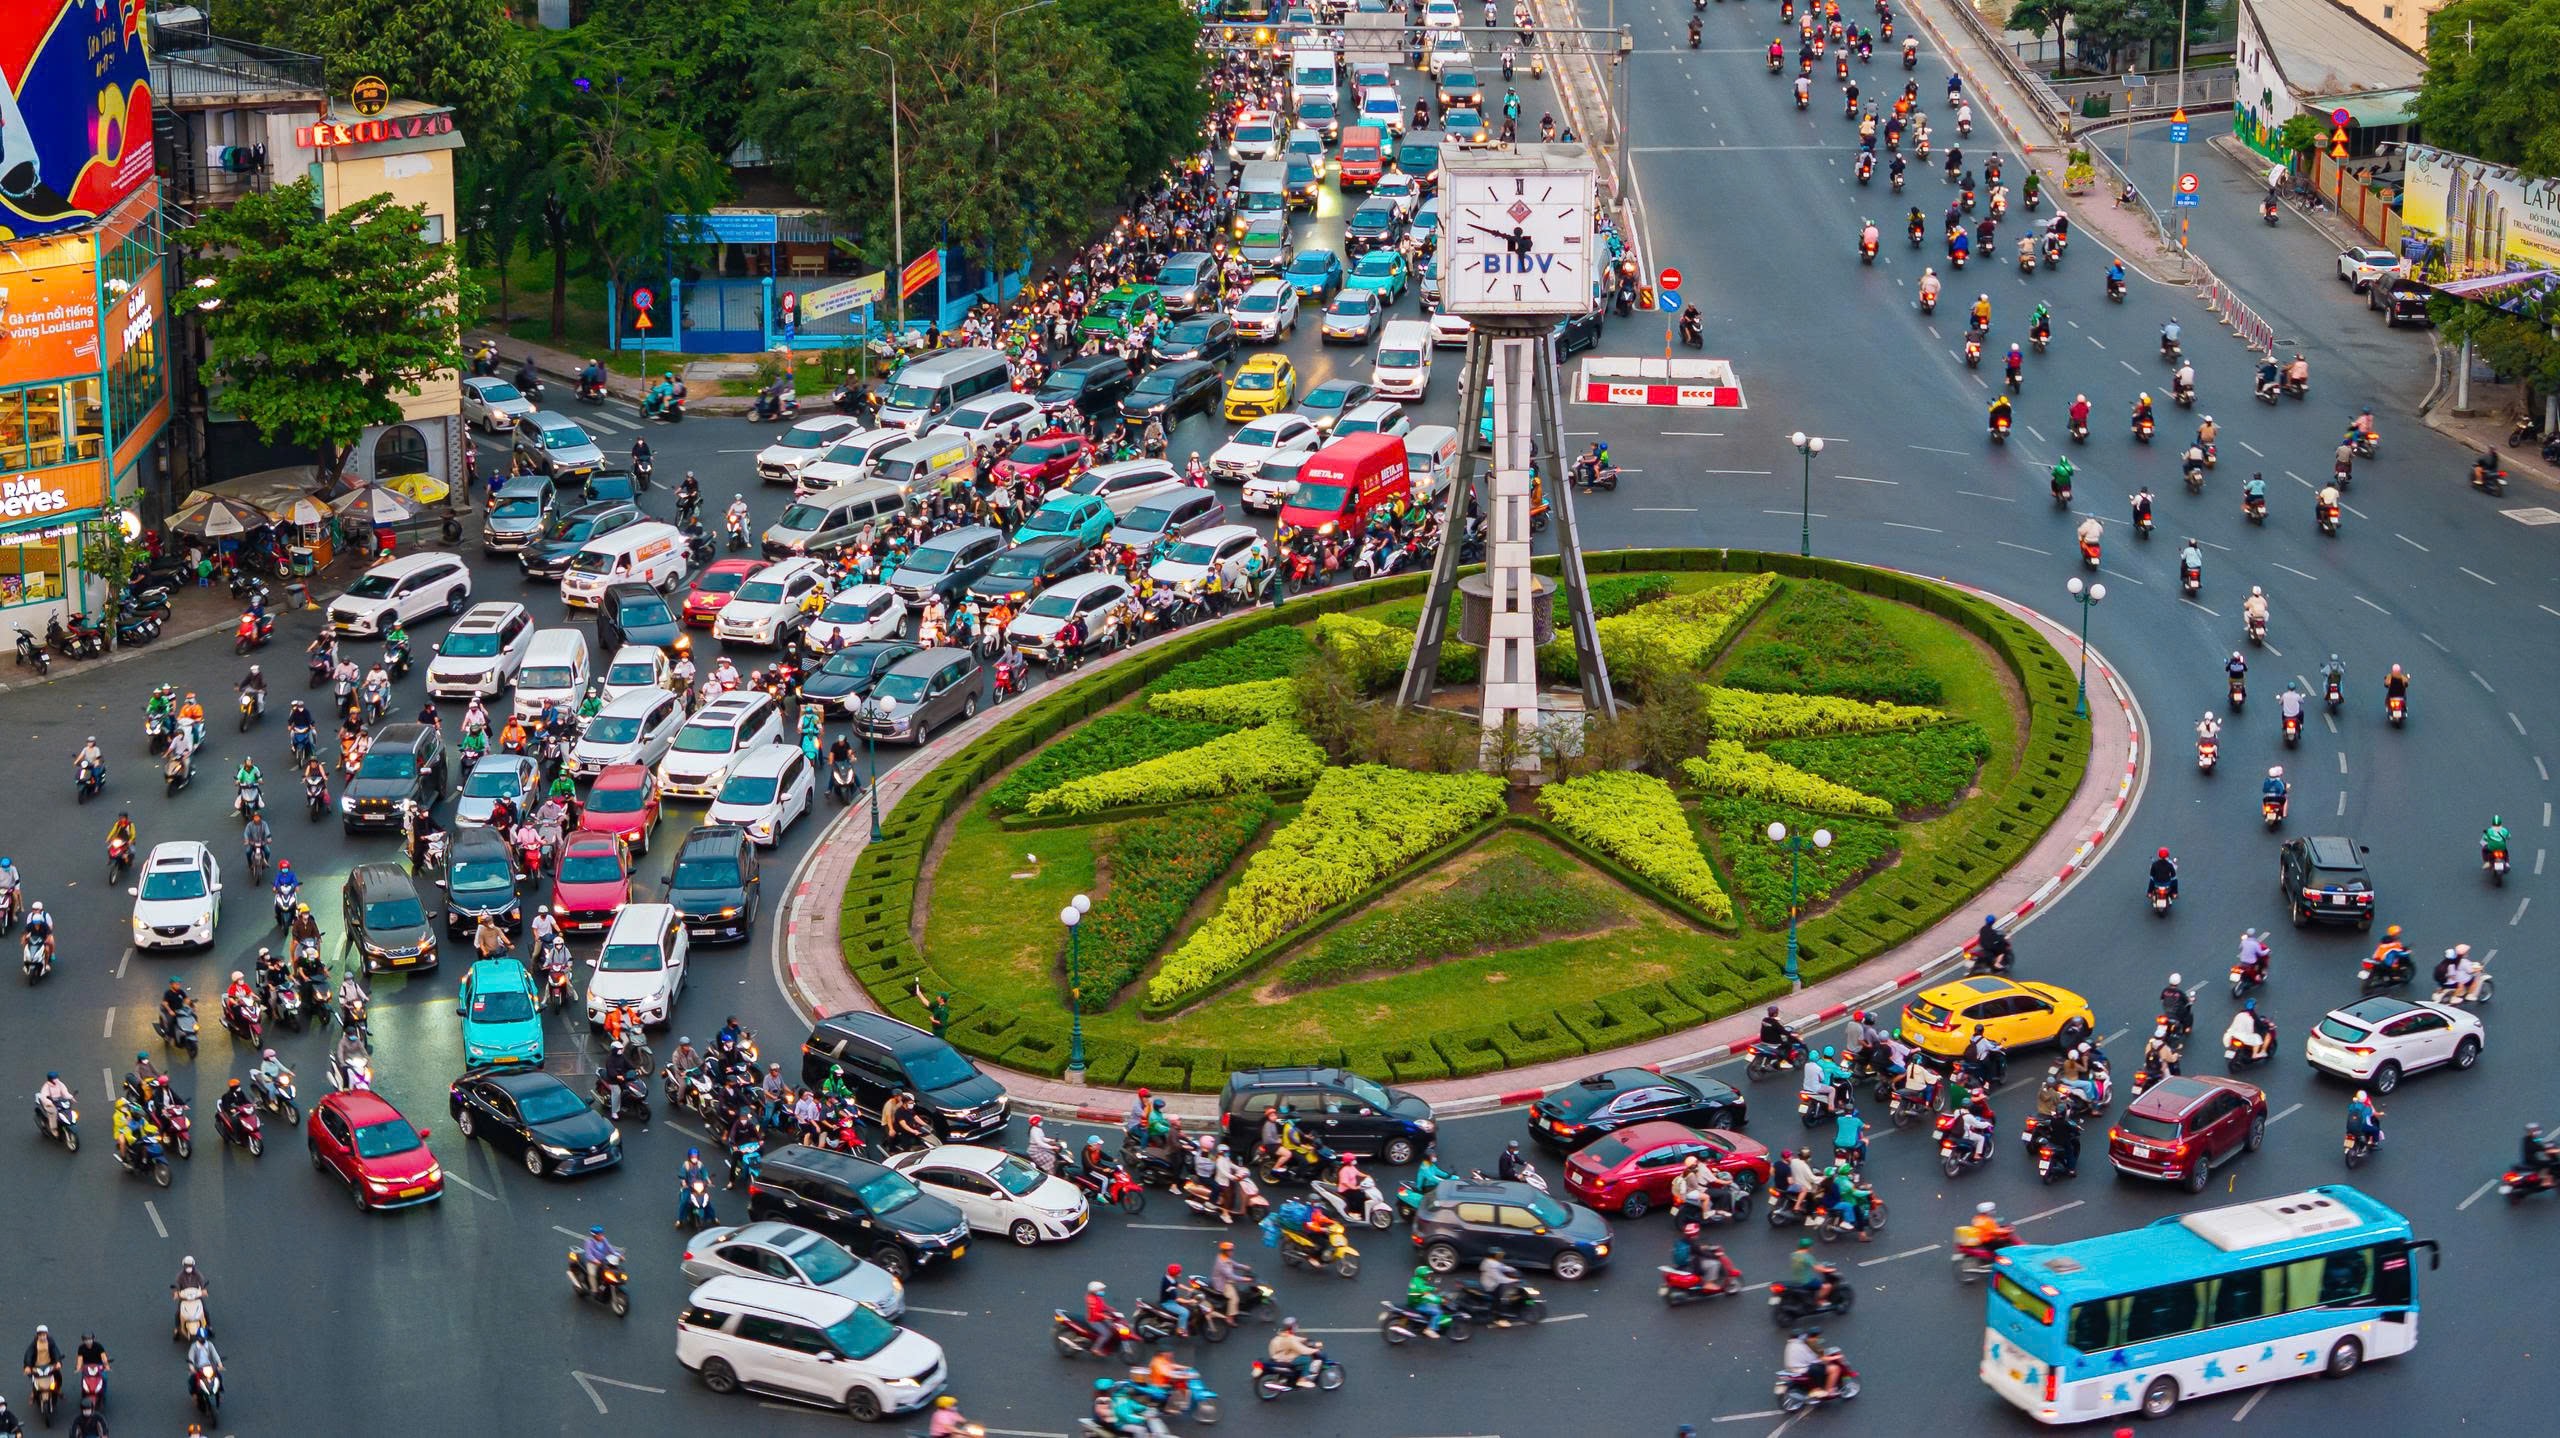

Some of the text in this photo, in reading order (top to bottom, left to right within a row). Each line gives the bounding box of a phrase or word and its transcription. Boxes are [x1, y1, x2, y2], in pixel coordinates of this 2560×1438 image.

[333, 124, 352, 146] &
[408, 113, 454, 138] 245
[1484, 253, 1553, 274] BIDV
[8, 313, 24, 325] Gà
[25, 311, 45, 323] rán
[10, 318, 95, 339] vùng Louisiana
[3, 474, 41, 498] RÁN
[44, 526, 79, 539] CHICKEN
